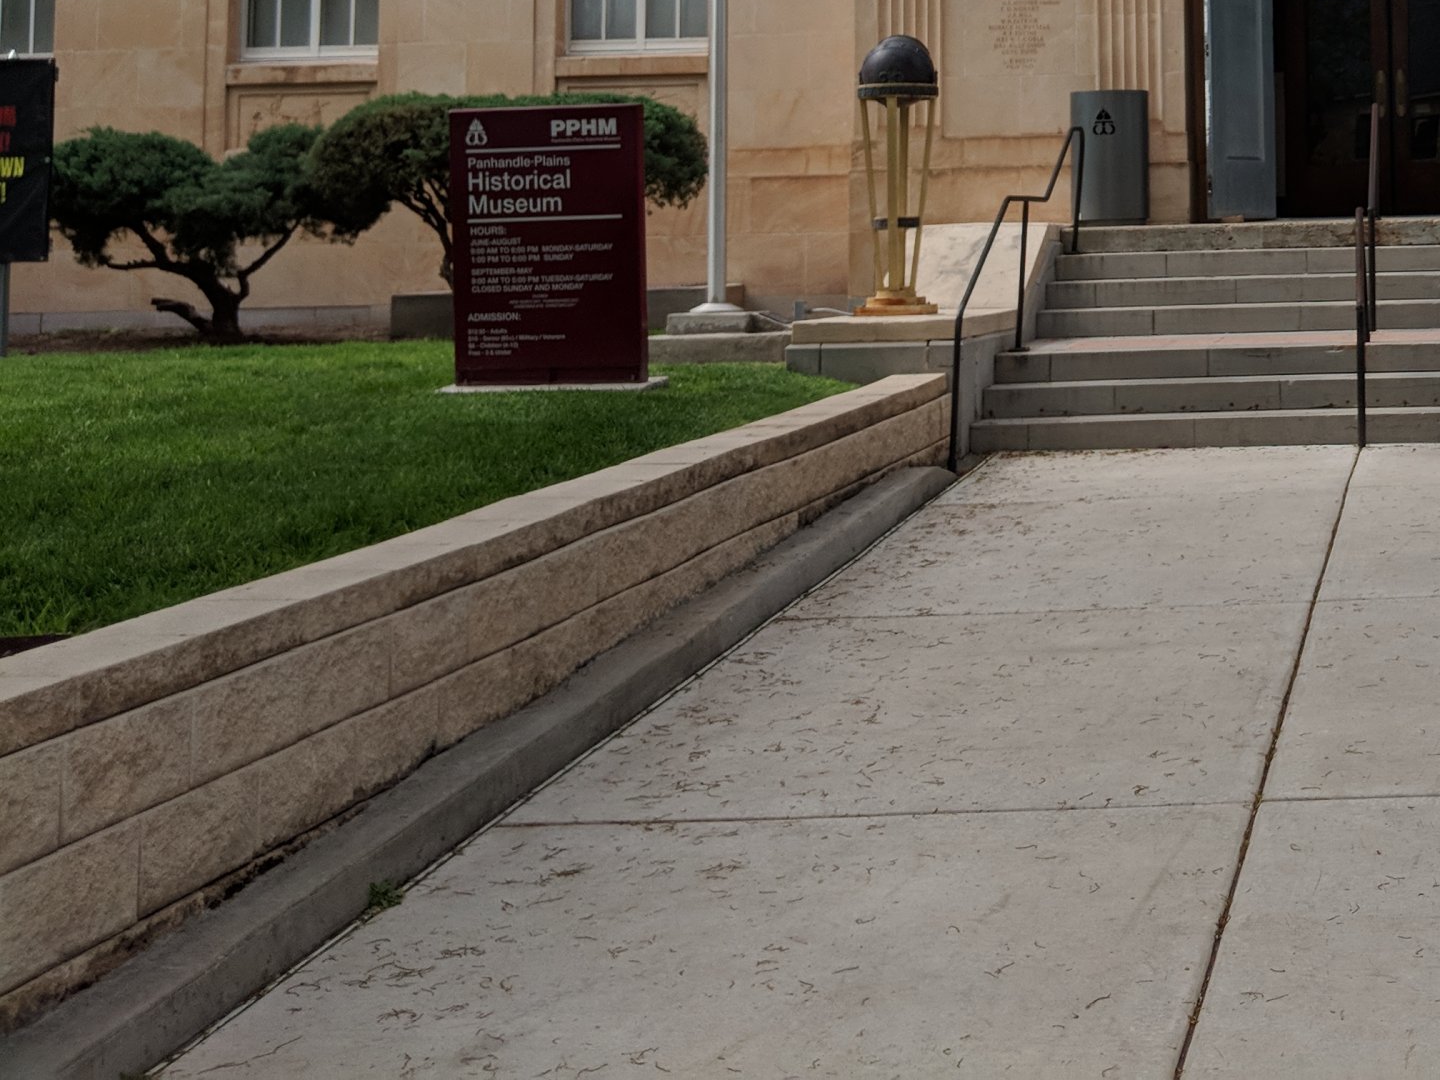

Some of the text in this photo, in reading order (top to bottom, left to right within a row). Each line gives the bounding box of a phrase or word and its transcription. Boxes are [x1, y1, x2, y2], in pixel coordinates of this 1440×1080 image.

[550, 117, 617, 138] PPHM
[468, 154, 570, 169] Panhandle-Plains
[468, 169, 571, 192] Historical
[468, 192, 562, 215] Museum
[472, 285, 502, 293] CLOSED
[534, 283, 550, 292] AND
[552, 282, 584, 291] MONDAY
[468, 312, 521, 322] ADMISSION:
